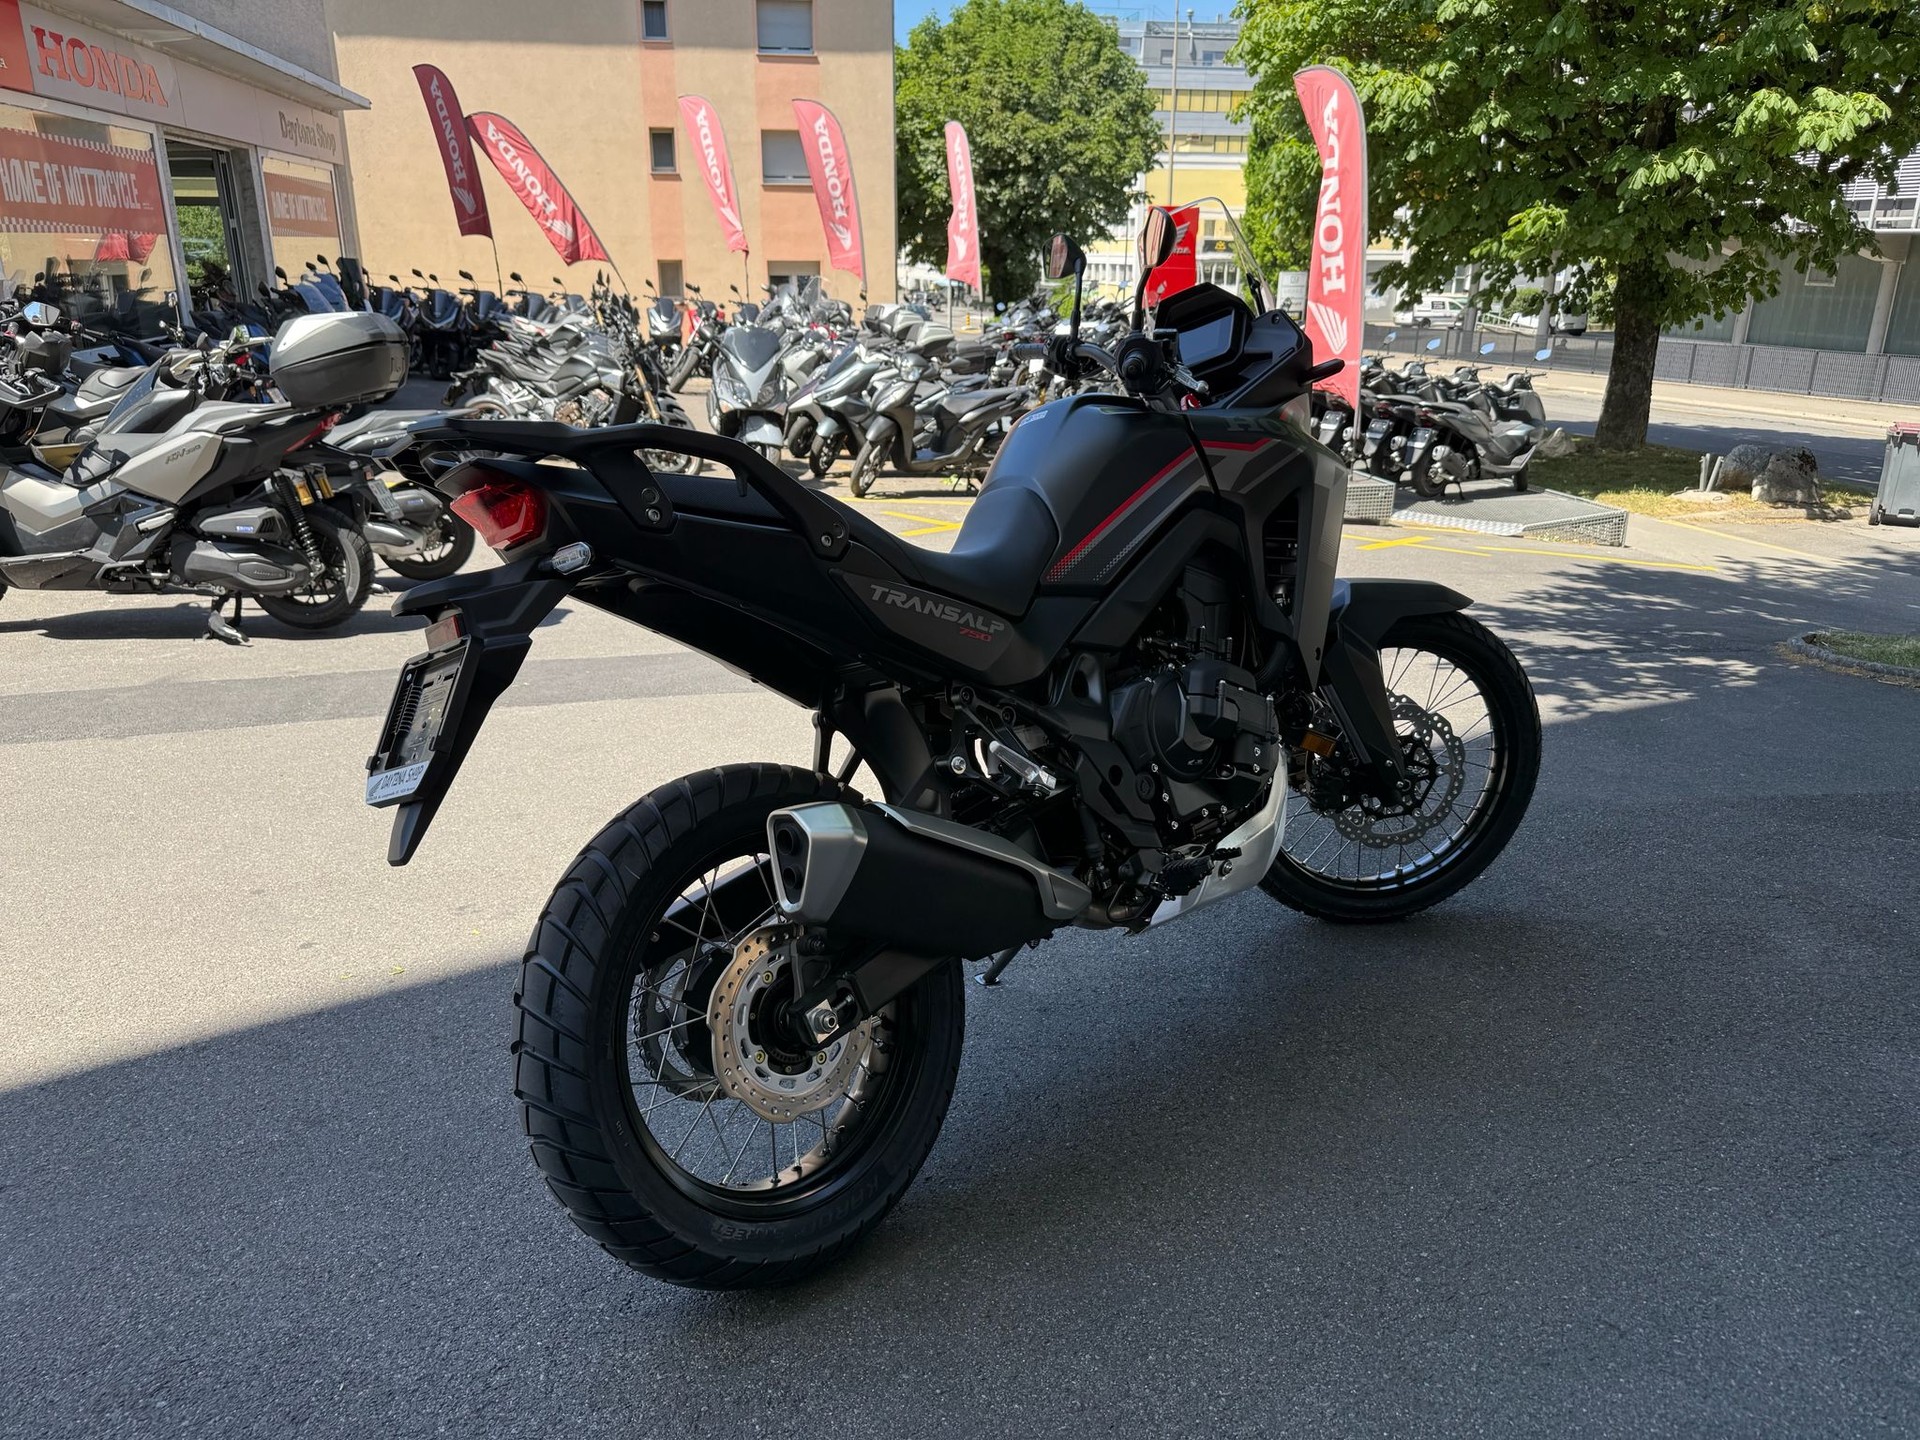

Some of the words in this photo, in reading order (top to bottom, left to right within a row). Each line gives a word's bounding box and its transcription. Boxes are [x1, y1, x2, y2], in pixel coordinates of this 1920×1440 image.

[30, 25, 169, 108] HONDA
[278, 110, 317, 148] Daytona
[315, 122, 337, 157] Shop
[430, 74, 468, 184] HONDA
[487, 119, 558, 215] HONDA
[813, 112, 849, 220] HONDA
[0, 157, 48, 204] HOME
[43, 162, 63, 206] OF
[1318, 89, 1347, 296] HONDA
[870, 583, 1006, 634] TRANSALP
[958, 626, 993, 642] 750
